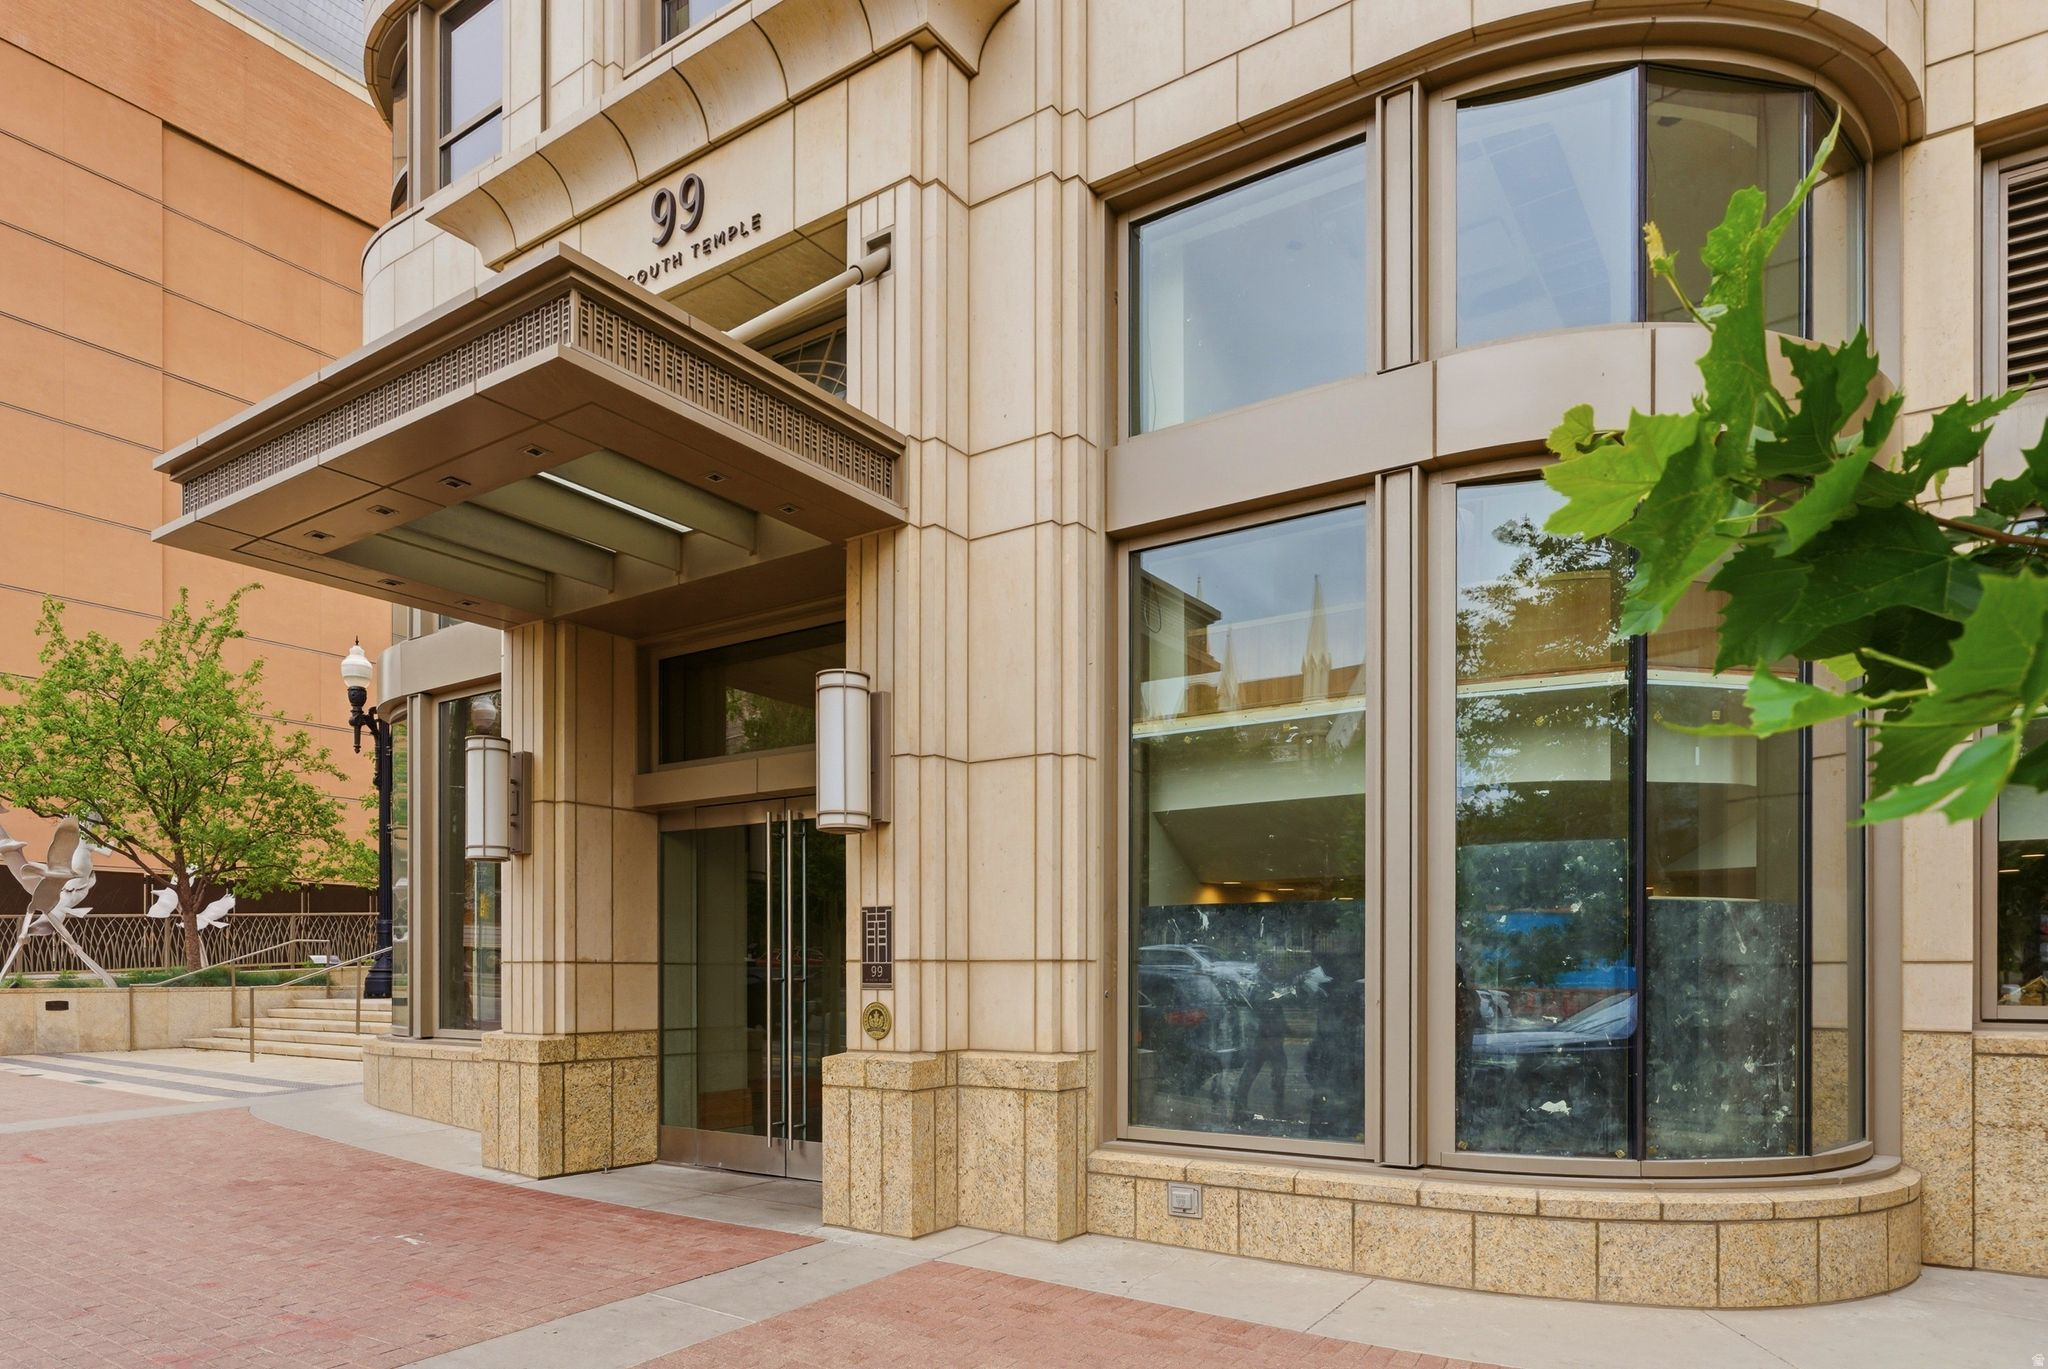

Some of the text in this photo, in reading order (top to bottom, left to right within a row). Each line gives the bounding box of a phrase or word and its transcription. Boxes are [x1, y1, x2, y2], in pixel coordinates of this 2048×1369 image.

[651, 173, 705, 247] 99
[690, 213, 762, 258] TEMPLE
[871, 965, 883, 978] 99
